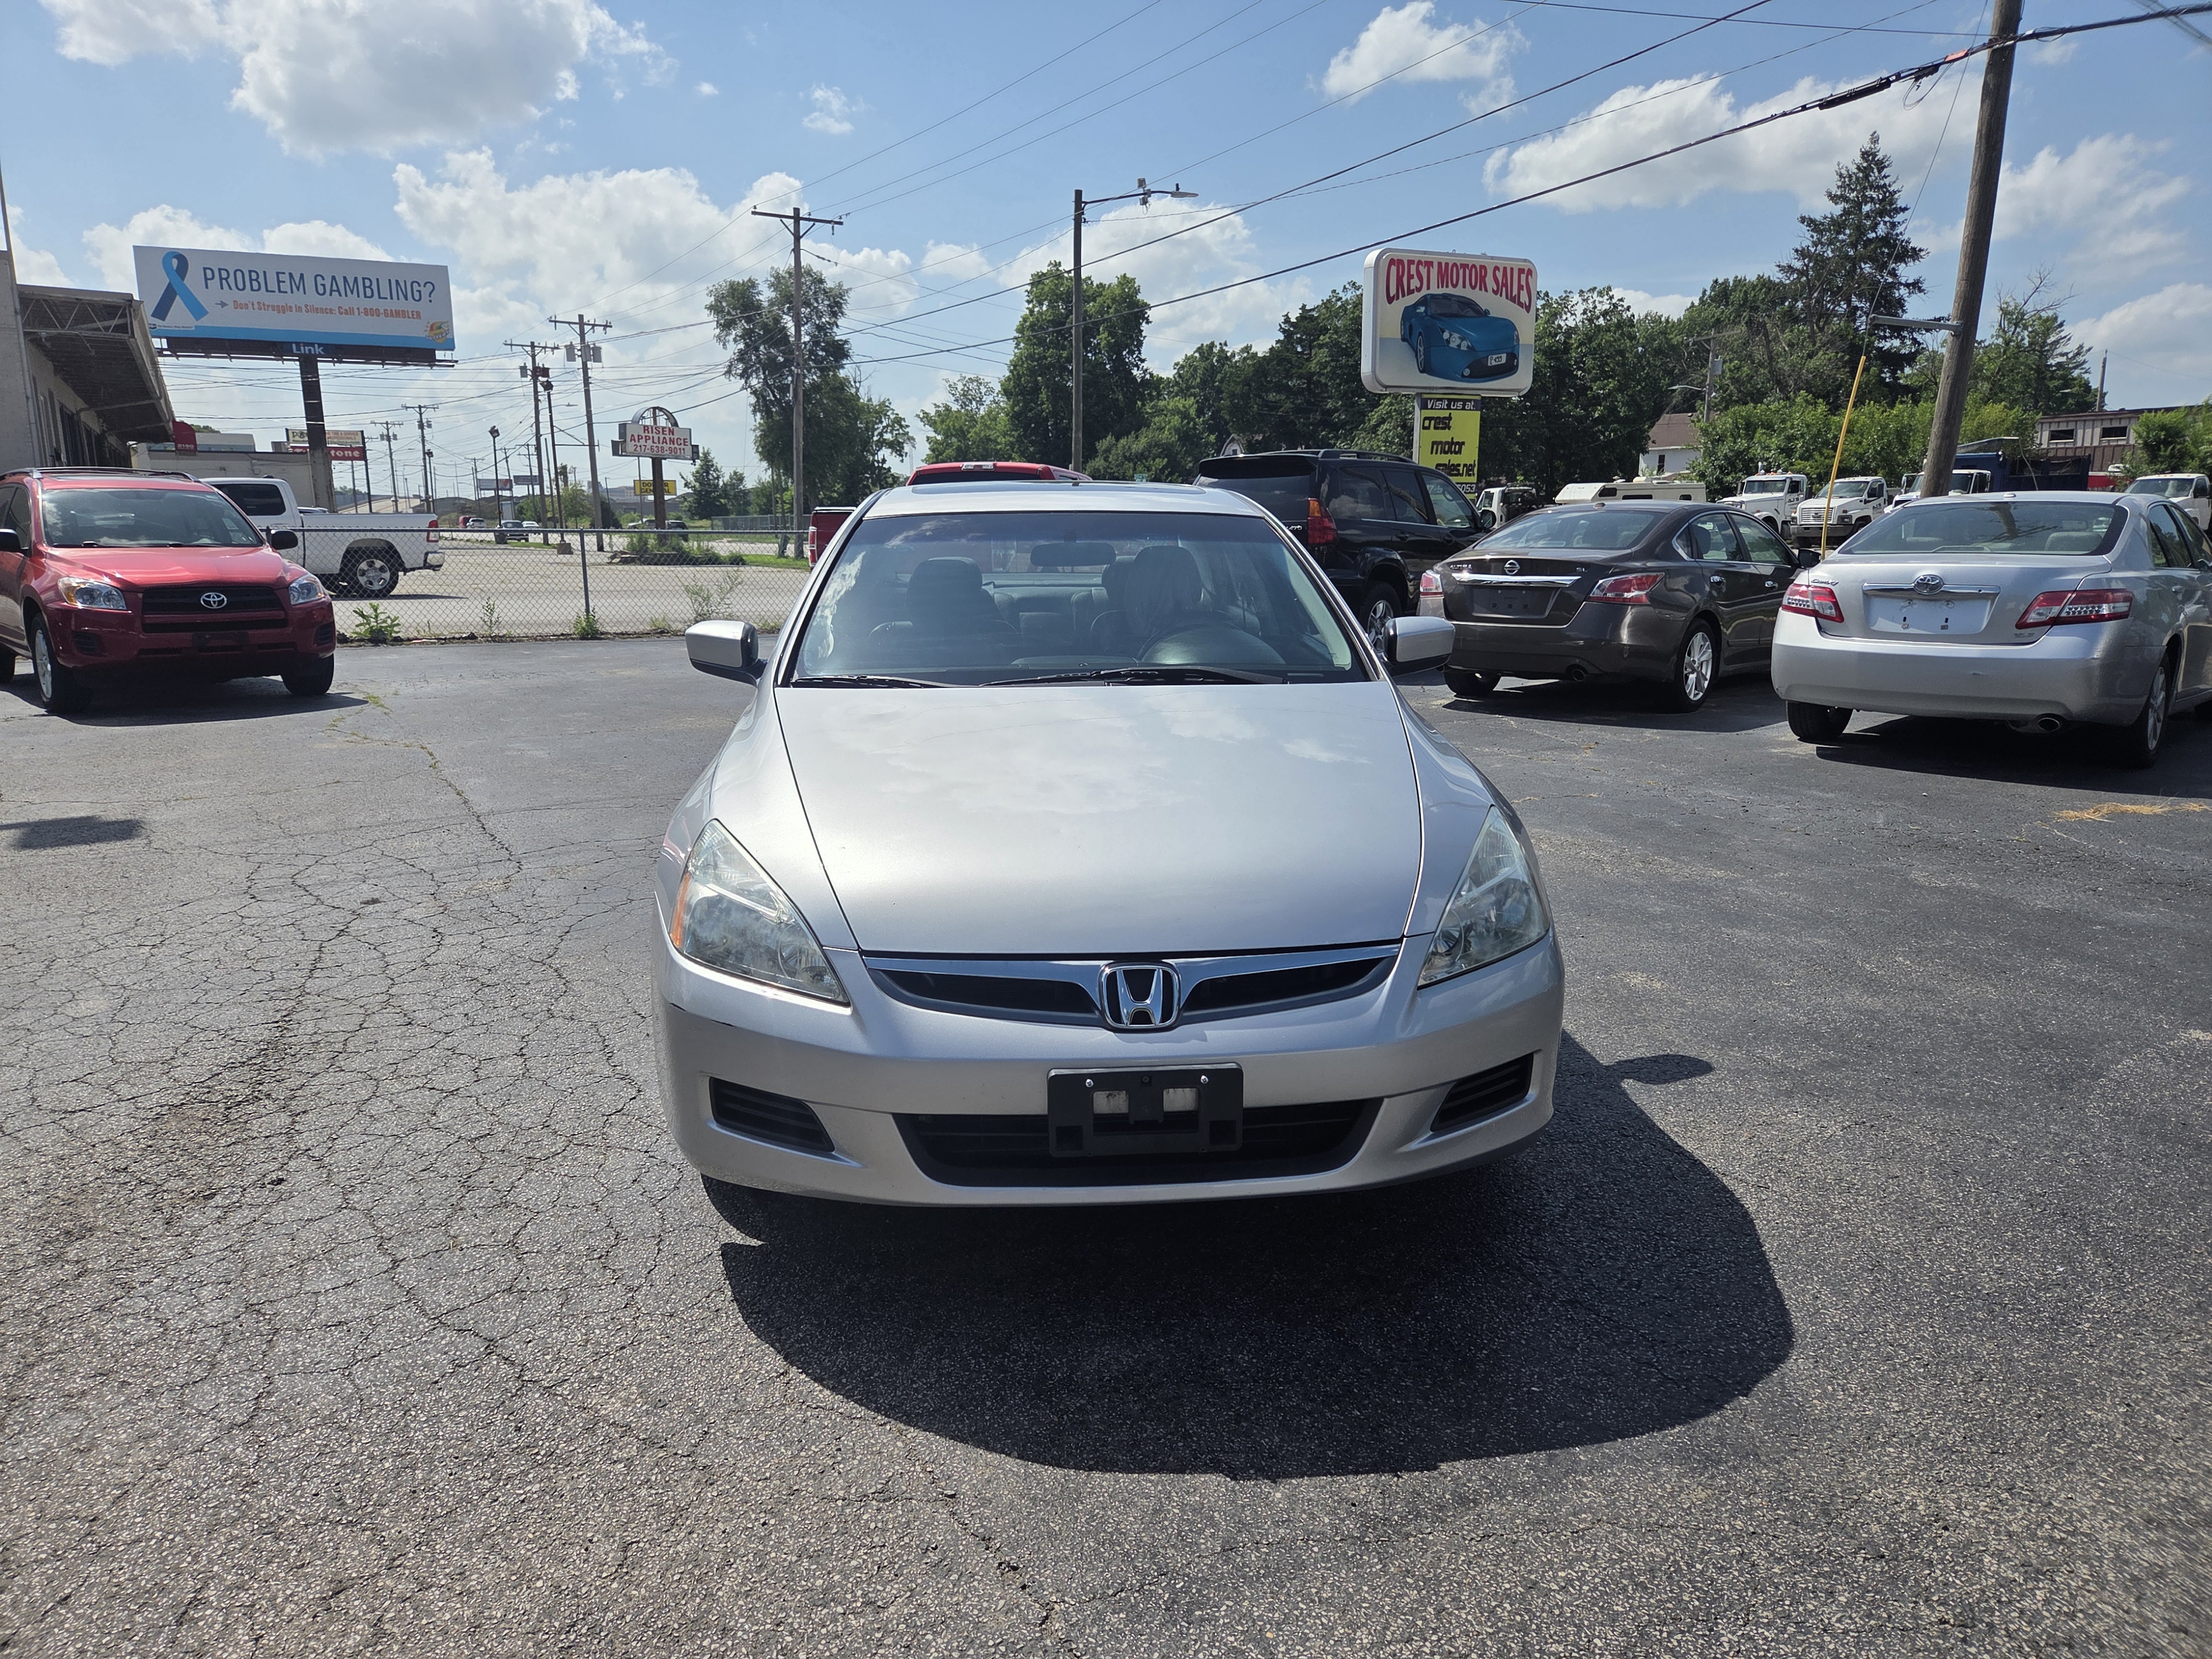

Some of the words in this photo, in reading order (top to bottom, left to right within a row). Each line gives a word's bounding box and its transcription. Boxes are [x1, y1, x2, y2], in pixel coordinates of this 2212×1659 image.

[203, 267, 306, 295] PROBLEM
[314, 274, 435, 302] GAMBLING?
[1386, 258, 1433, 305] CREST
[1437, 262, 1488, 293] MOTOR
[1492, 265, 1532, 314] SALES
[233, 300, 255, 310] Don't
[257, 301, 293, 314] Struggle
[305, 304, 336, 315] Silence:
[338, 306, 354, 316] Call
[356, 307, 421, 320] 1-800-GAMBLER
[292, 343, 325, 354] Link
[1427, 399, 1448, 409] Visit
[1422, 413, 1453, 431] crest
[643, 426, 674, 436] RISEN
[630, 434, 688, 446] APPLIANCE
[1430, 437, 1465, 455] motor
[634, 444, 686, 455] 217-638-9011
